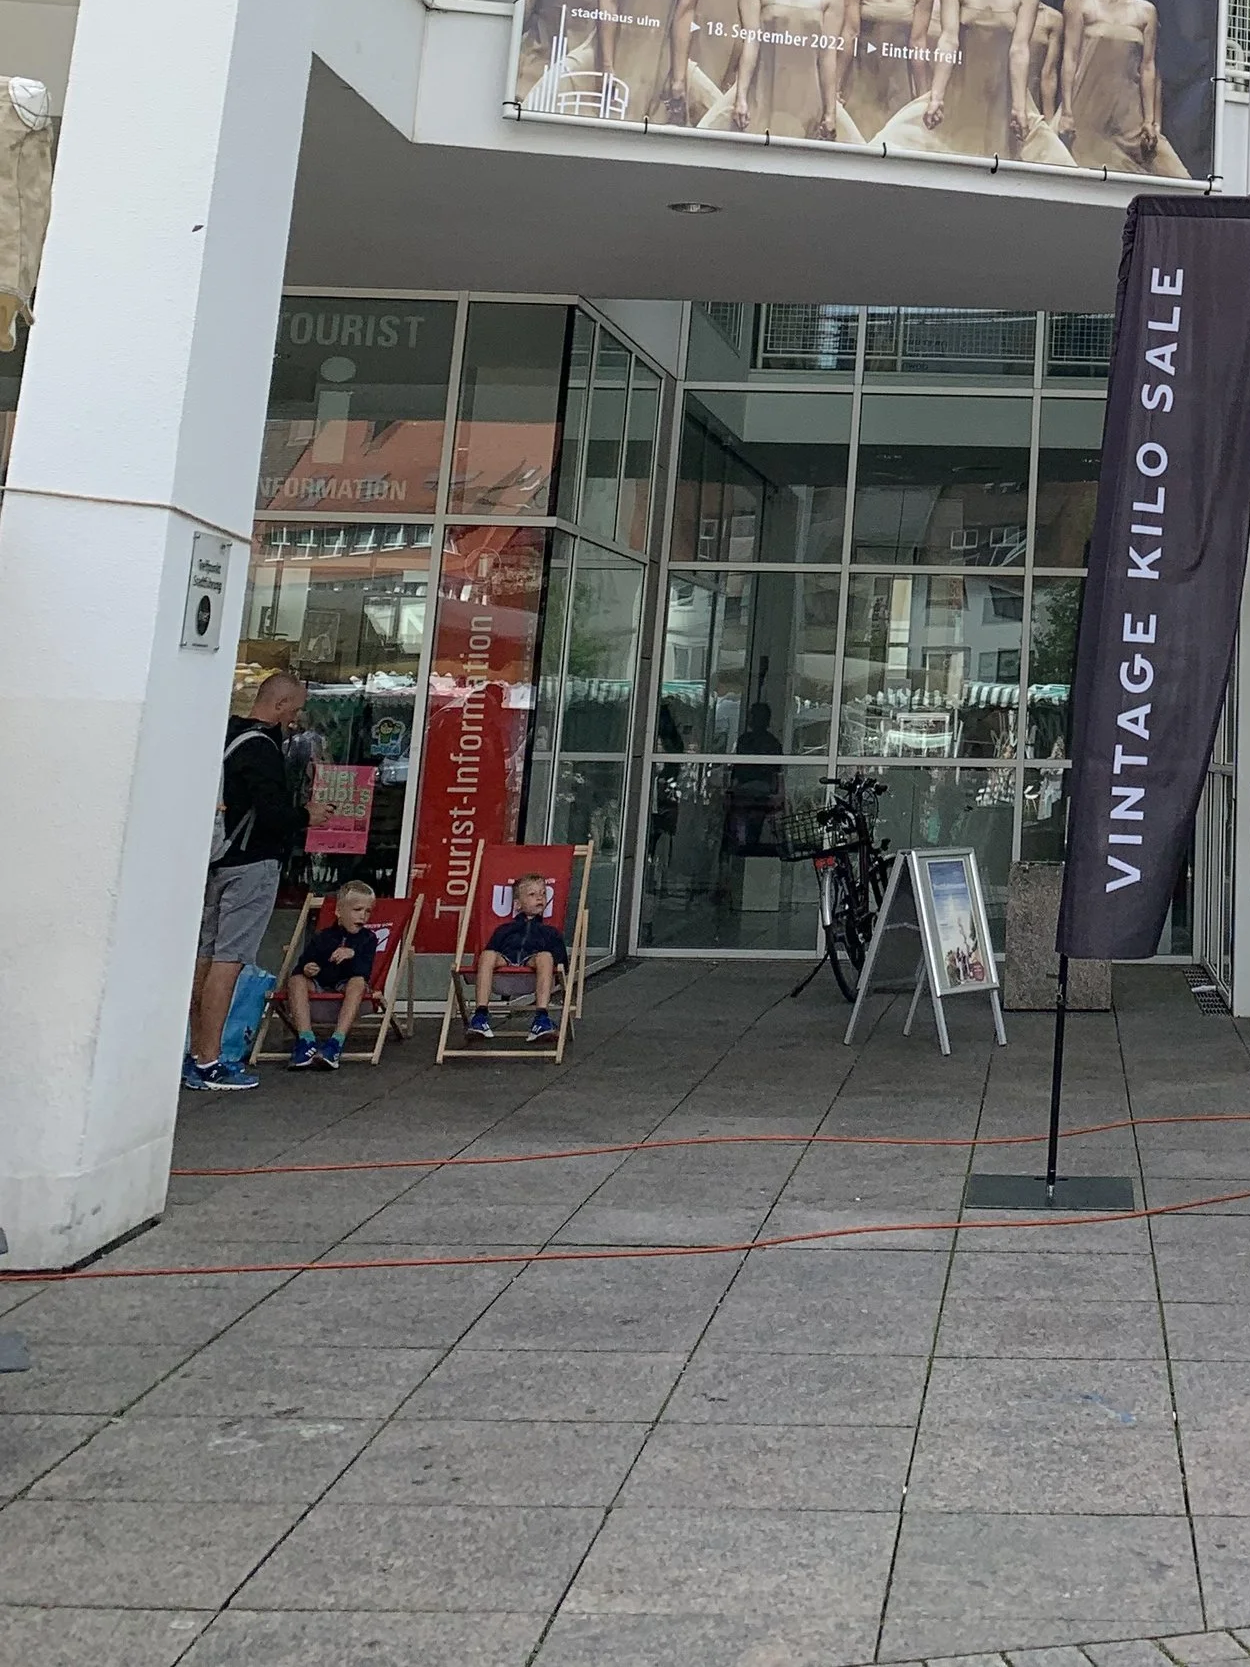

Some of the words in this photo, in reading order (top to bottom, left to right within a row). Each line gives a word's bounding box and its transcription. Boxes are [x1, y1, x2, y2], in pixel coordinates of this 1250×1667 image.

[571, 7, 634, 24] stadthaus
[636, 14, 660, 28] ulm
[706, 21, 728, 37] 18.
[731, 24, 808, 47] September
[810, 33, 845, 51] 2022
[881, 42, 931, 62] Eintritt
[934, 47, 963, 66] frei!
[1140, 267, 1184, 413] SALE
[259, 476, 407, 501] NFORMATION
[1127, 441, 1169, 580] KILO
[434, 615, 493, 920] Tourist-Information
[1105, 612, 1158, 893] VINTAGE
